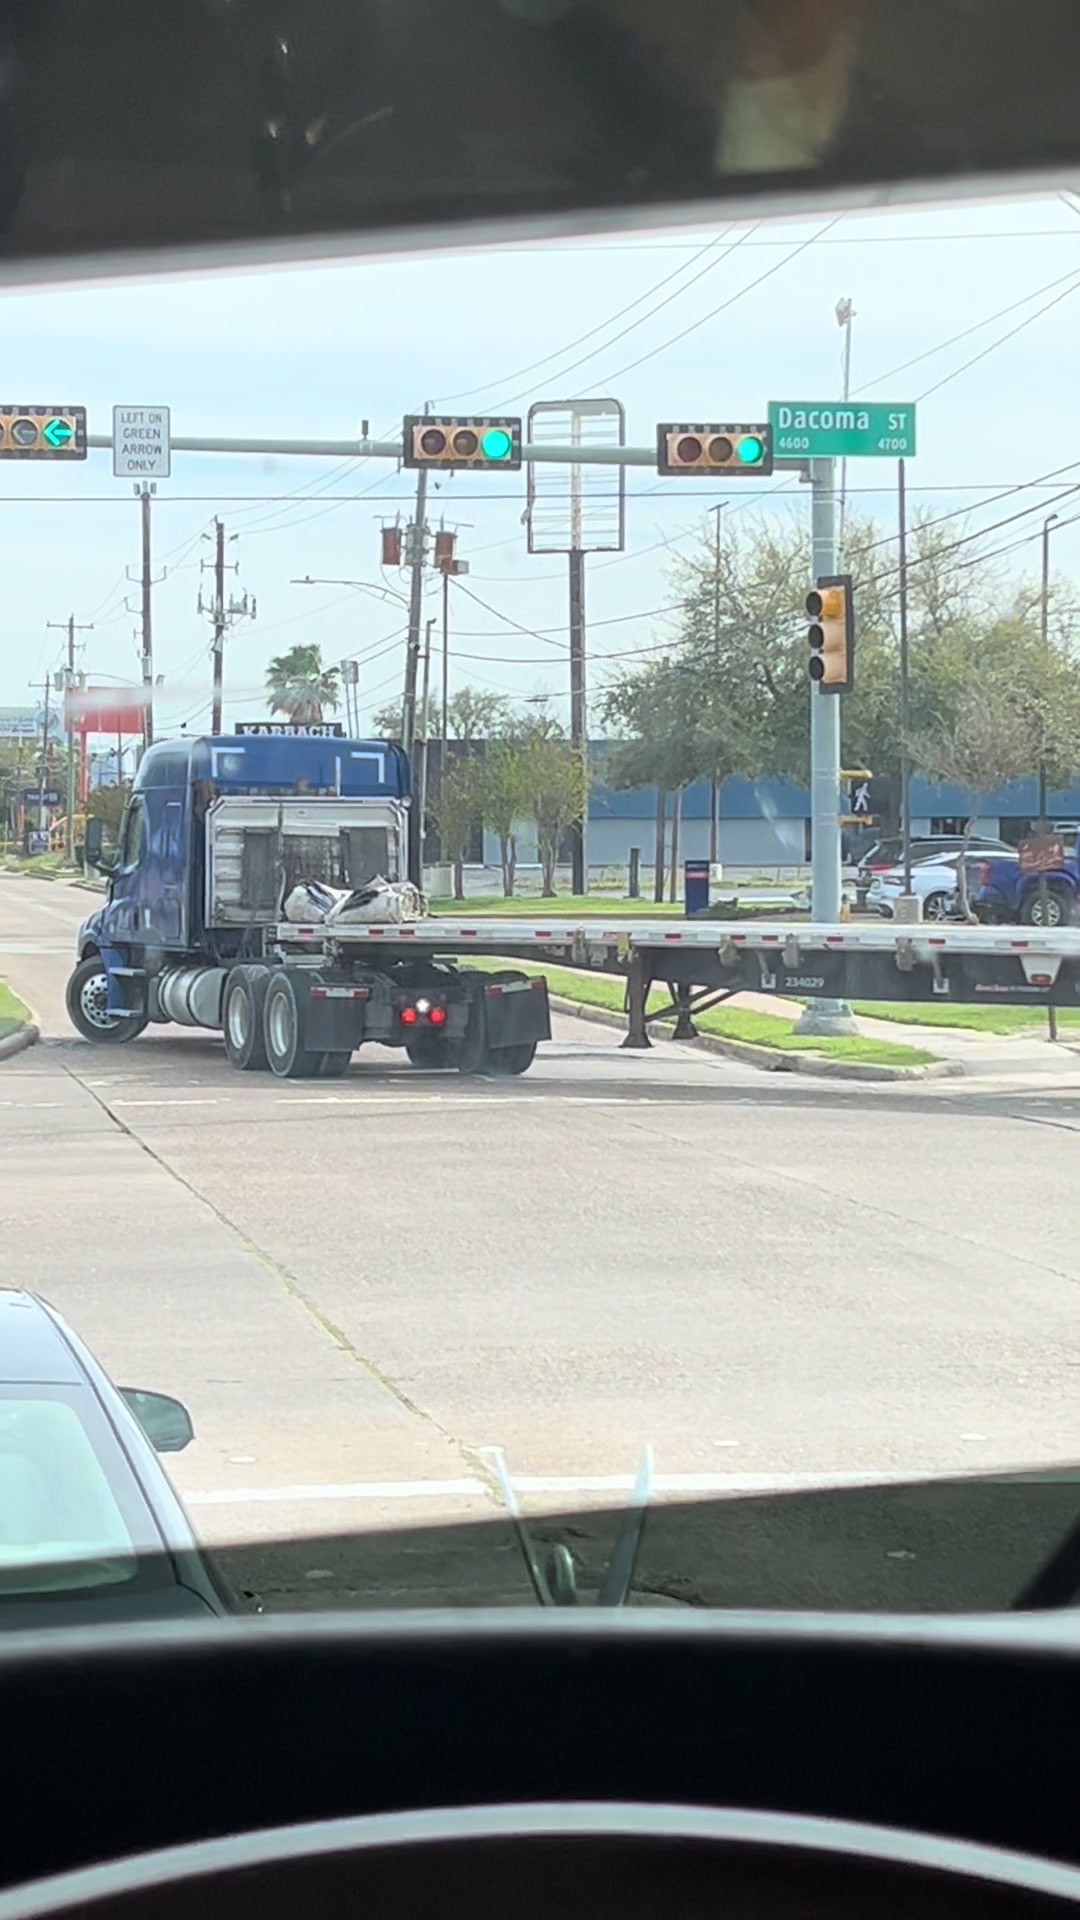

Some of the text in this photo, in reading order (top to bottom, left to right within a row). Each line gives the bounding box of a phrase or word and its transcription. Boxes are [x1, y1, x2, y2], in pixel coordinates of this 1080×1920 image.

[121, 412, 162, 424] LEFT ON
[778, 407, 907, 431] Dacoma ST
[123, 428, 161, 439] GREEN
[778, 436, 810, 449] 4600
[877, 438, 907, 450] 4700
[122, 444, 162, 455] ARROW
[127, 459, 156, 471] ONLY
